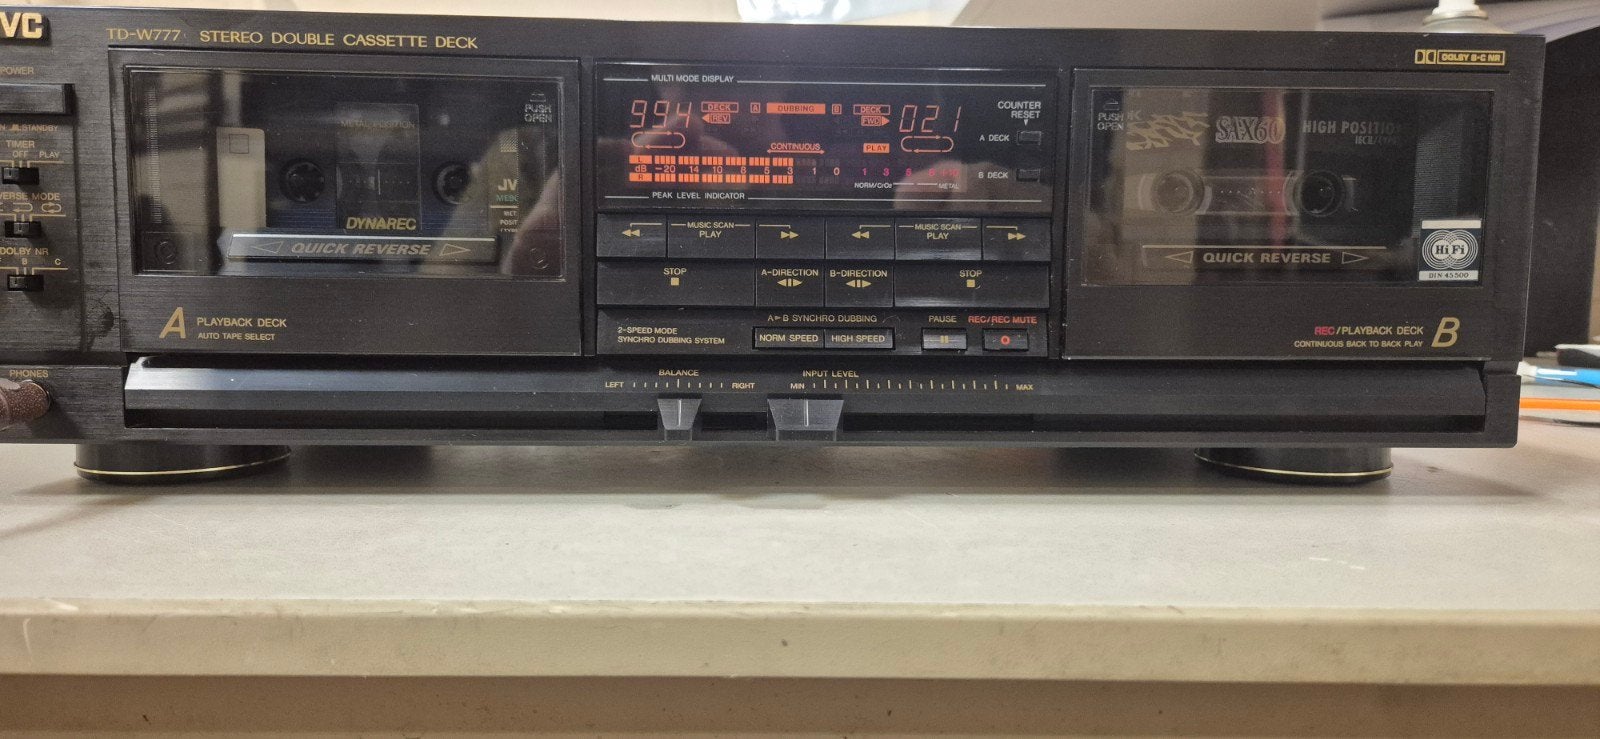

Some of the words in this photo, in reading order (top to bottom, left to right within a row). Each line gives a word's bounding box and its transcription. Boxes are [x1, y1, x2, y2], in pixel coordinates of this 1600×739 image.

[106, 28, 181, 41] TD-W777
[200, 31, 263, 43] STEREO
[271, 33, 334, 46] DOUBLE
[343, 34, 428, 47] CASSETTE
[435, 36, 478, 49] DECK
[1442, 53, 1468, 61] DOLBY
[1488, 54, 1500, 62] NR
[525, 104, 551, 113] PUSH
[707, 103, 731, 111] DECK
[998, 101, 1041, 109] COUNTER
[630, 100, 692, 128] 994
[860, 106, 881, 114] DECK
[525, 113, 552, 122] OPEN
[862, 117, 880, 125] FWD
[899, 105, 961, 132] 021
[1098, 113, 1124, 121] PUSH
[1097, 122, 1124, 131] OPEN
[1303, 120, 1336, 133] HIGH
[1341, 121, 1400, 135] POSITIO
[6, 140, 35, 148] TIMER
[834, 167, 840, 175] 0
[862, 168, 867, 176] 1
[883, 168, 889, 176] 3
[32, 193, 60, 201] MODE
[346, 217, 417, 230] DYNAREC
[35, 248, 48, 256] NR
[292, 243, 348, 255] QUICK
[353, 244, 431, 255] REVERSE
[1435, 245, 1449, 254] Hi
[1451, 245, 1465, 254] Fi
[21, 257, 28, 265] B
[1203, 252, 1254, 263] QUICK
[1260, 253, 1331, 264] REVERSE
[159, 306, 187, 339] A
[197, 317, 252, 327] PLAYBACK
[258, 318, 287, 327] DECK
[838, 315, 877, 323] DUBBING
[617, 326, 653, 334] 2-SPEED
[1314, 326, 1392, 335] REC/PLAYBACK
[1397, 326, 1424, 335] DECK
[1431, 317, 1460, 348] B
[198, 332, 219, 340] AUTO
[222, 332, 242, 340] TAPE
[245, 333, 275, 341] SELECT
[1294, 340, 1344, 348] CONTINUOUS
